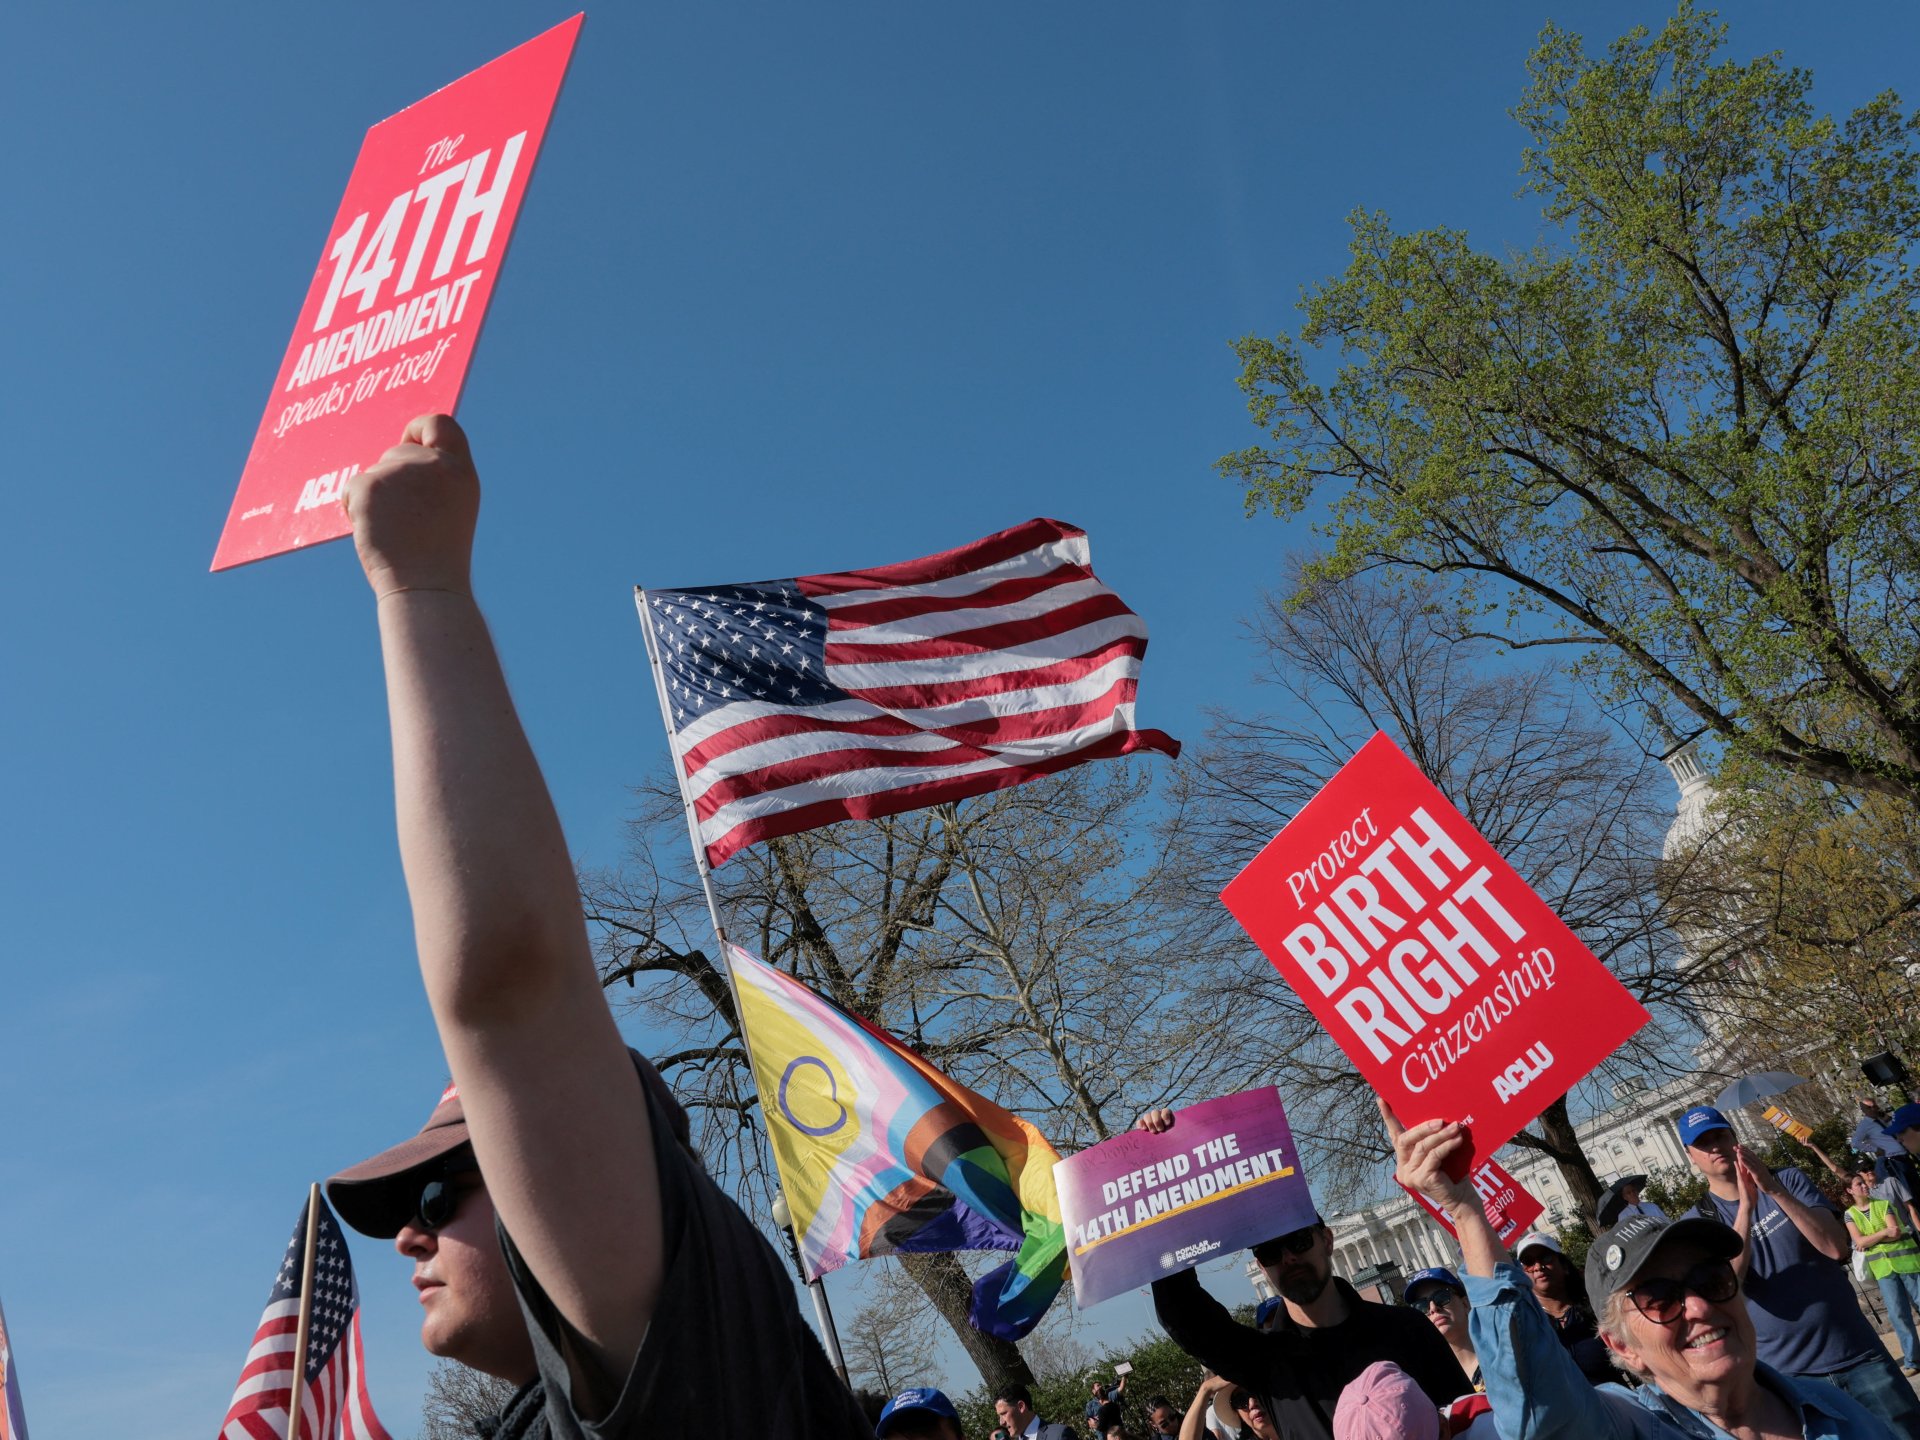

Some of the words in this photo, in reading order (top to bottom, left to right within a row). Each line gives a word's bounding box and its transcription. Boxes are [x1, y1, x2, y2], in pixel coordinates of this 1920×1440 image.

[418, 133, 464, 175] The
[313, 130, 527, 333] 14TH
[286, 269, 482, 392] AMENDMENT
[273, 378, 350, 439] speaks
[342, 365, 388, 416] for
[384, 333, 458, 392] itself
[1282, 806, 1472, 999] BIRTH
[1285, 806, 1378, 910] Protect
[1334, 866, 1527, 1065] RIGHT
[1401, 945, 1557, 1094] Citizenship
[1491, 1040, 1555, 1104] ACLU
[1075, 1206, 1129, 1246] 14TH
[1134, 1149, 1283, 1223] AMENDMENT
[1102, 1153, 1190, 1205] DEFEND
[1193, 1133, 1240, 1169] THE
[1175, 1240, 1209, 1256] POPULAR
[1176, 1241, 1221, 1262] DEMOCRACY
